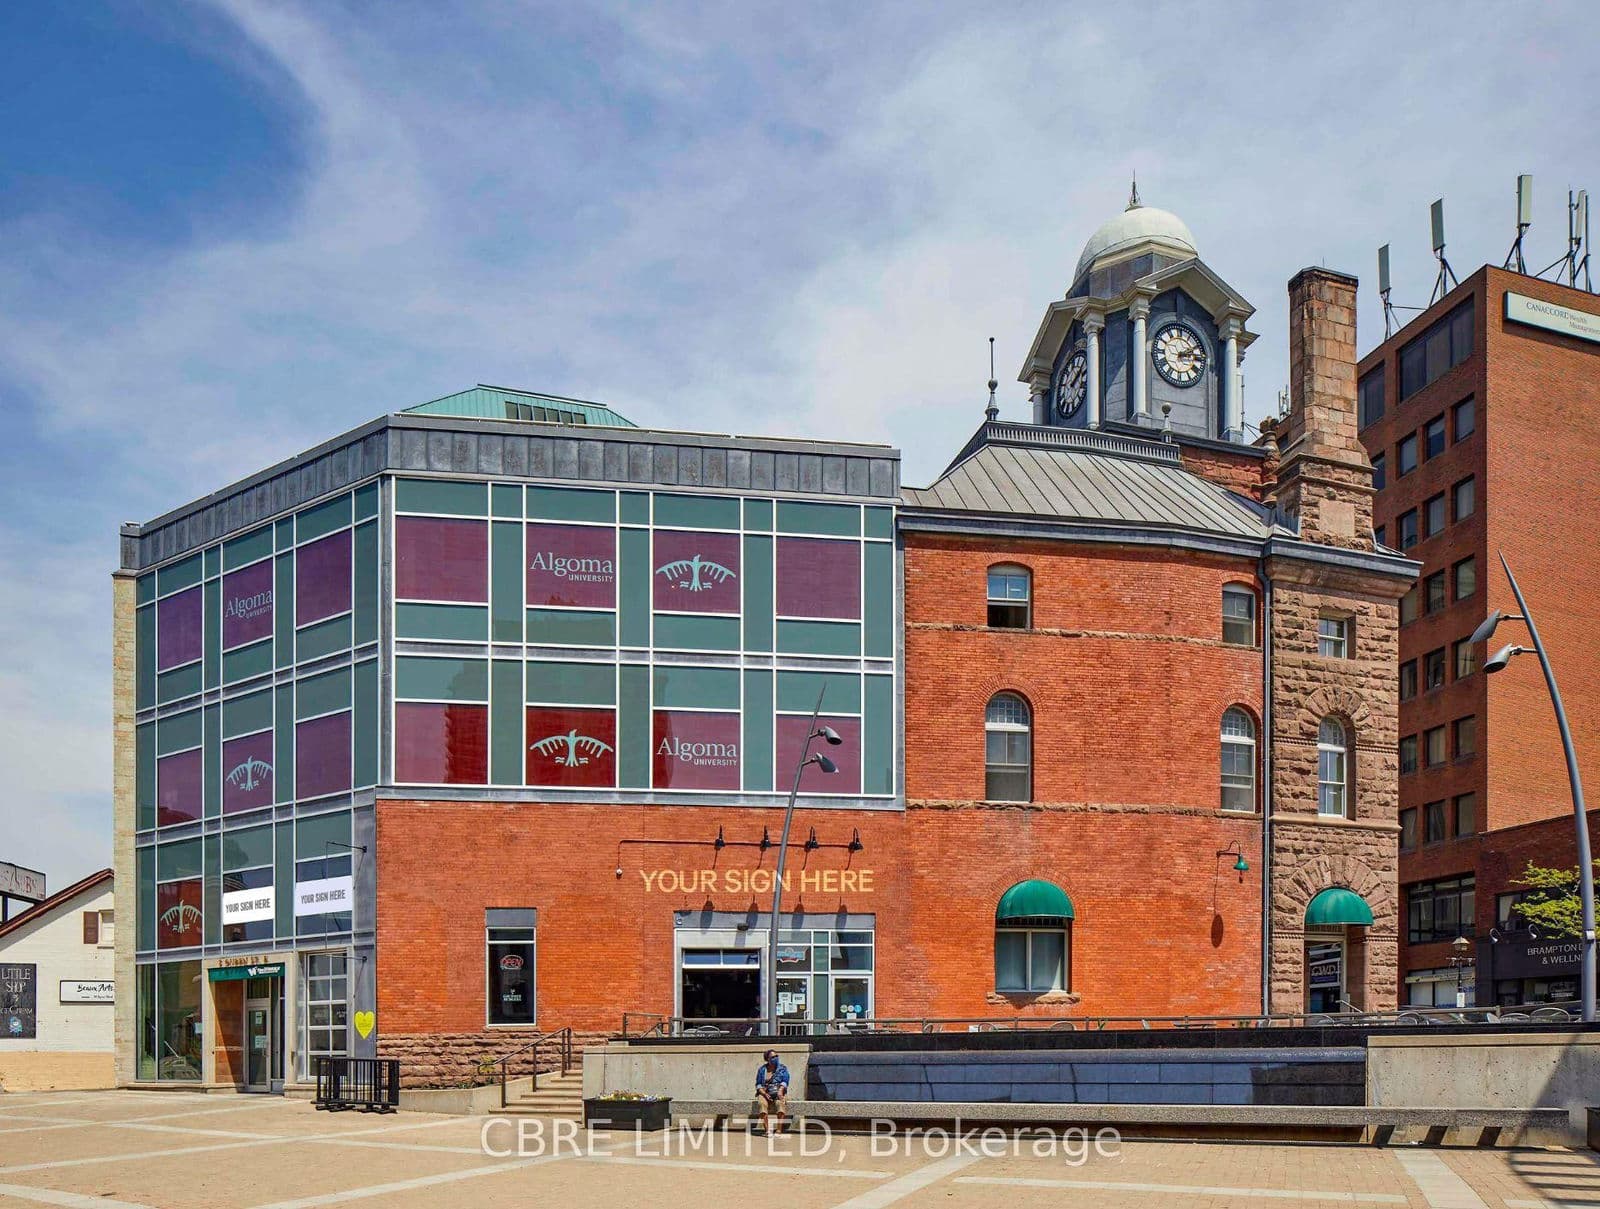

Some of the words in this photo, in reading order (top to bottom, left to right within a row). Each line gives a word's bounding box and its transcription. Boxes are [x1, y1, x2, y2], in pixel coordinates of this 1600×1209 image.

[529, 551, 613, 577] Algoma
[568, 573, 613, 583] UNIVERSITY
[225, 590, 273, 618] Algoma
[656, 736, 737, 762] Algoma
[693, 758, 737, 767] UNIVERSITY
[639, 869, 718, 894] YOUR
[725, 869, 791, 894] SIGN
[801, 869, 874, 893] HERE
[300, 893, 315, 905] YOUR
[315, 892, 329, 903] SIGN
[329, 889, 346, 901] HERE
[225, 902, 240, 914] YOUR
[240, 900, 254, 912] SIGN
[254, 898, 271, 910] HERE
[1527, 944, 1577, 956] BRAMPTON
[1542, 956, 1549, 965] &
[1, 967, 31, 980] LITTLE
[6, 980, 26, 993] SHOP
